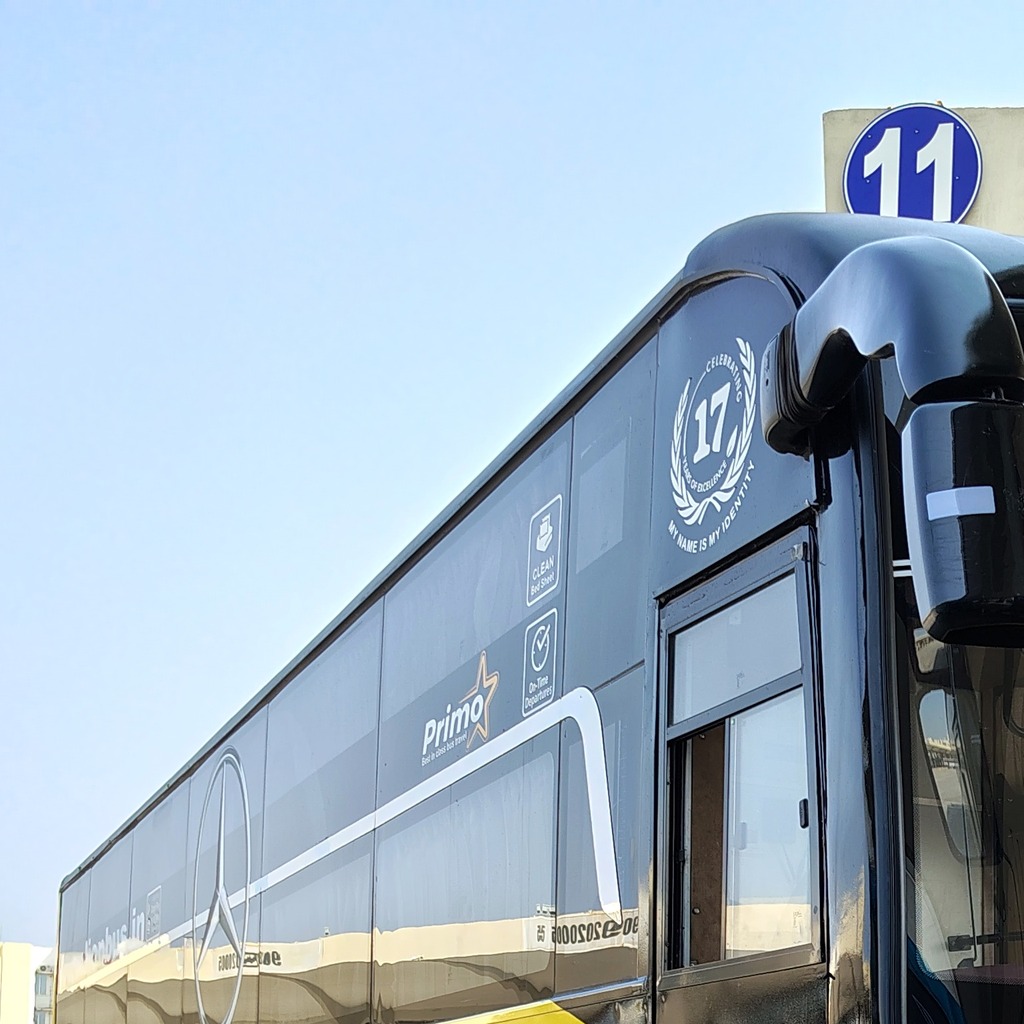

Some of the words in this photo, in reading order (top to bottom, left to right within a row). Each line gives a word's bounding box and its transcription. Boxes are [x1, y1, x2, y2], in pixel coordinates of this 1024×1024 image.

[863, 122, 955, 222] 11
[705, 353, 743, 403] CELEBRATING
[694, 381, 731, 465] 17
[690, 480, 698, 491] OF
[697, 459, 728, 493] EXCELLENCE
[668, 519, 678, 540] MY
[676, 533, 699, 554] NAME
[699, 538, 707, 552] IS
[708, 526, 721, 547] MY
[721, 459, 755, 534] IDENTITY
[530, 581, 541, 596] Bed
[540, 572, 555, 591] Sheet
[532, 554, 555, 581] CLEAN
[524, 685, 553, 709] Departures
[528, 674, 549, 694] On-Time
[422, 694, 484, 756] Primo
